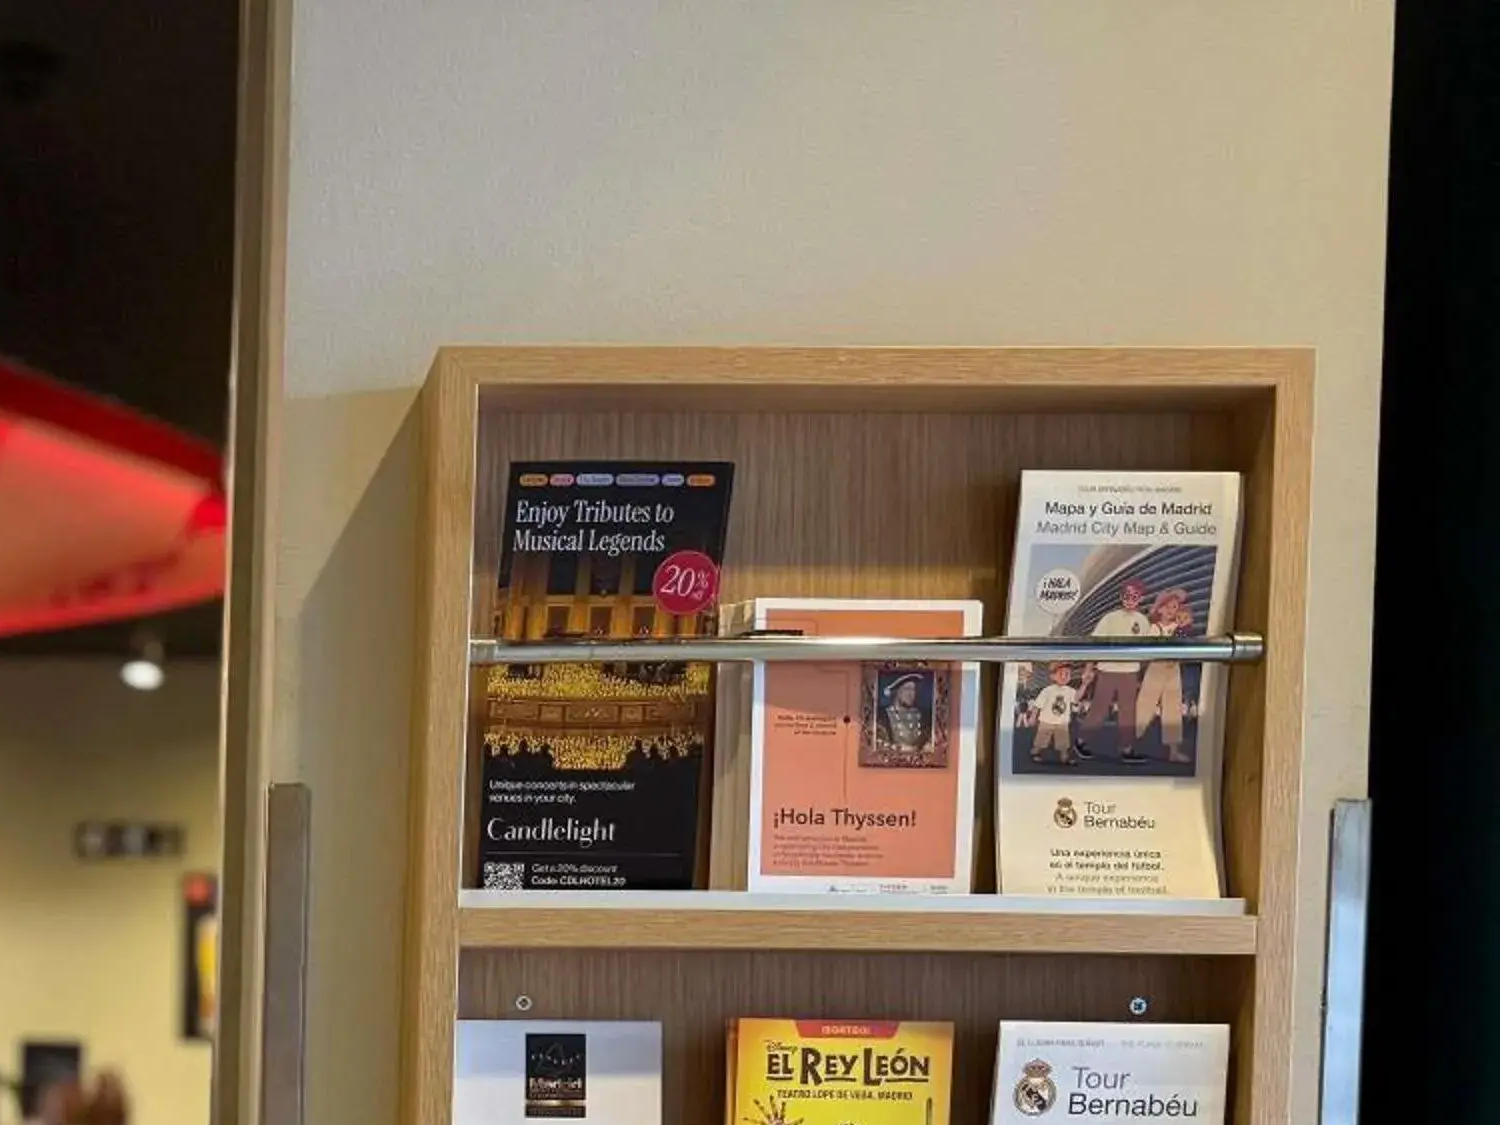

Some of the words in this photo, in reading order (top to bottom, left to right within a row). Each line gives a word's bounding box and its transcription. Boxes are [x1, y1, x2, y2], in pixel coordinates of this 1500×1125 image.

[516, 500, 570, 528] Enjoy
[574, 500, 650, 523] Tributes
[655, 503, 675, 523] to
[1045, 502, 1085, 516] Mapa
[1089, 505, 1097, 517] y
[1102, 501, 1135, 515] Guía
[1139, 502, 1157, 515] de
[1161, 502, 1212, 515] Madrid
[1036, 521, 1087, 535] Madrid
[1091, 521, 1117, 537] City
[1123, 522, 1155, 537] Map
[1159, 522, 1169, 535] &
[1175, 522, 1216, 536] Guide
[513, 530, 583, 552] Musical
[589, 530, 665, 556] Legends
[1083, 801, 1116, 814] Tour
[773, 808, 824, 829] ¡Hola
[831, 809, 916, 831] Thyssen!
[1083, 815, 1156, 829] Bernabéu
[487, 818, 615, 848] Candlelight
[766, 1053, 794, 1076] EL
[800, 1048, 858, 1086] REY
[863, 1047, 930, 1086] LEÓN
[1072, 1066, 1131, 1089] Tour
[1068, 1092, 1198, 1117] Bernabéu
